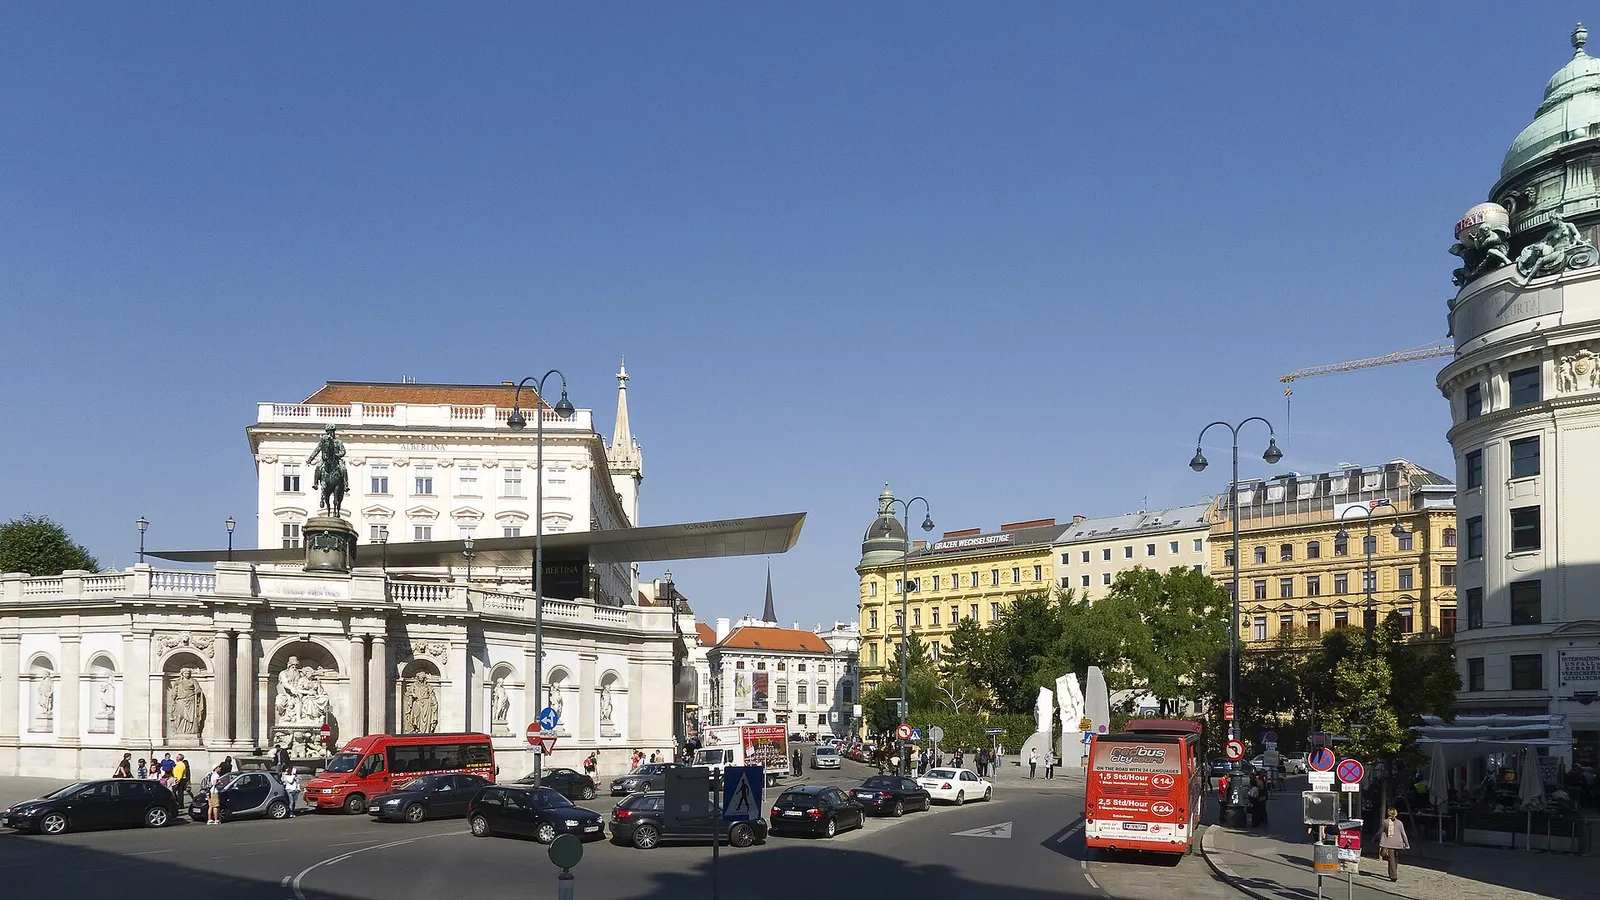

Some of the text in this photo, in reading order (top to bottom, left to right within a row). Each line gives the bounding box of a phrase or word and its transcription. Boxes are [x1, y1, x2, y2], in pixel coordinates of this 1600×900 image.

[401, 443, 445, 451] ALBERTINA
[934, 534, 1010, 549] GRAZER WECHSELSEITIGE
[1113, 773, 1149, 781] Std/Hour
[1112, 799, 1149, 807] Std/Hour
